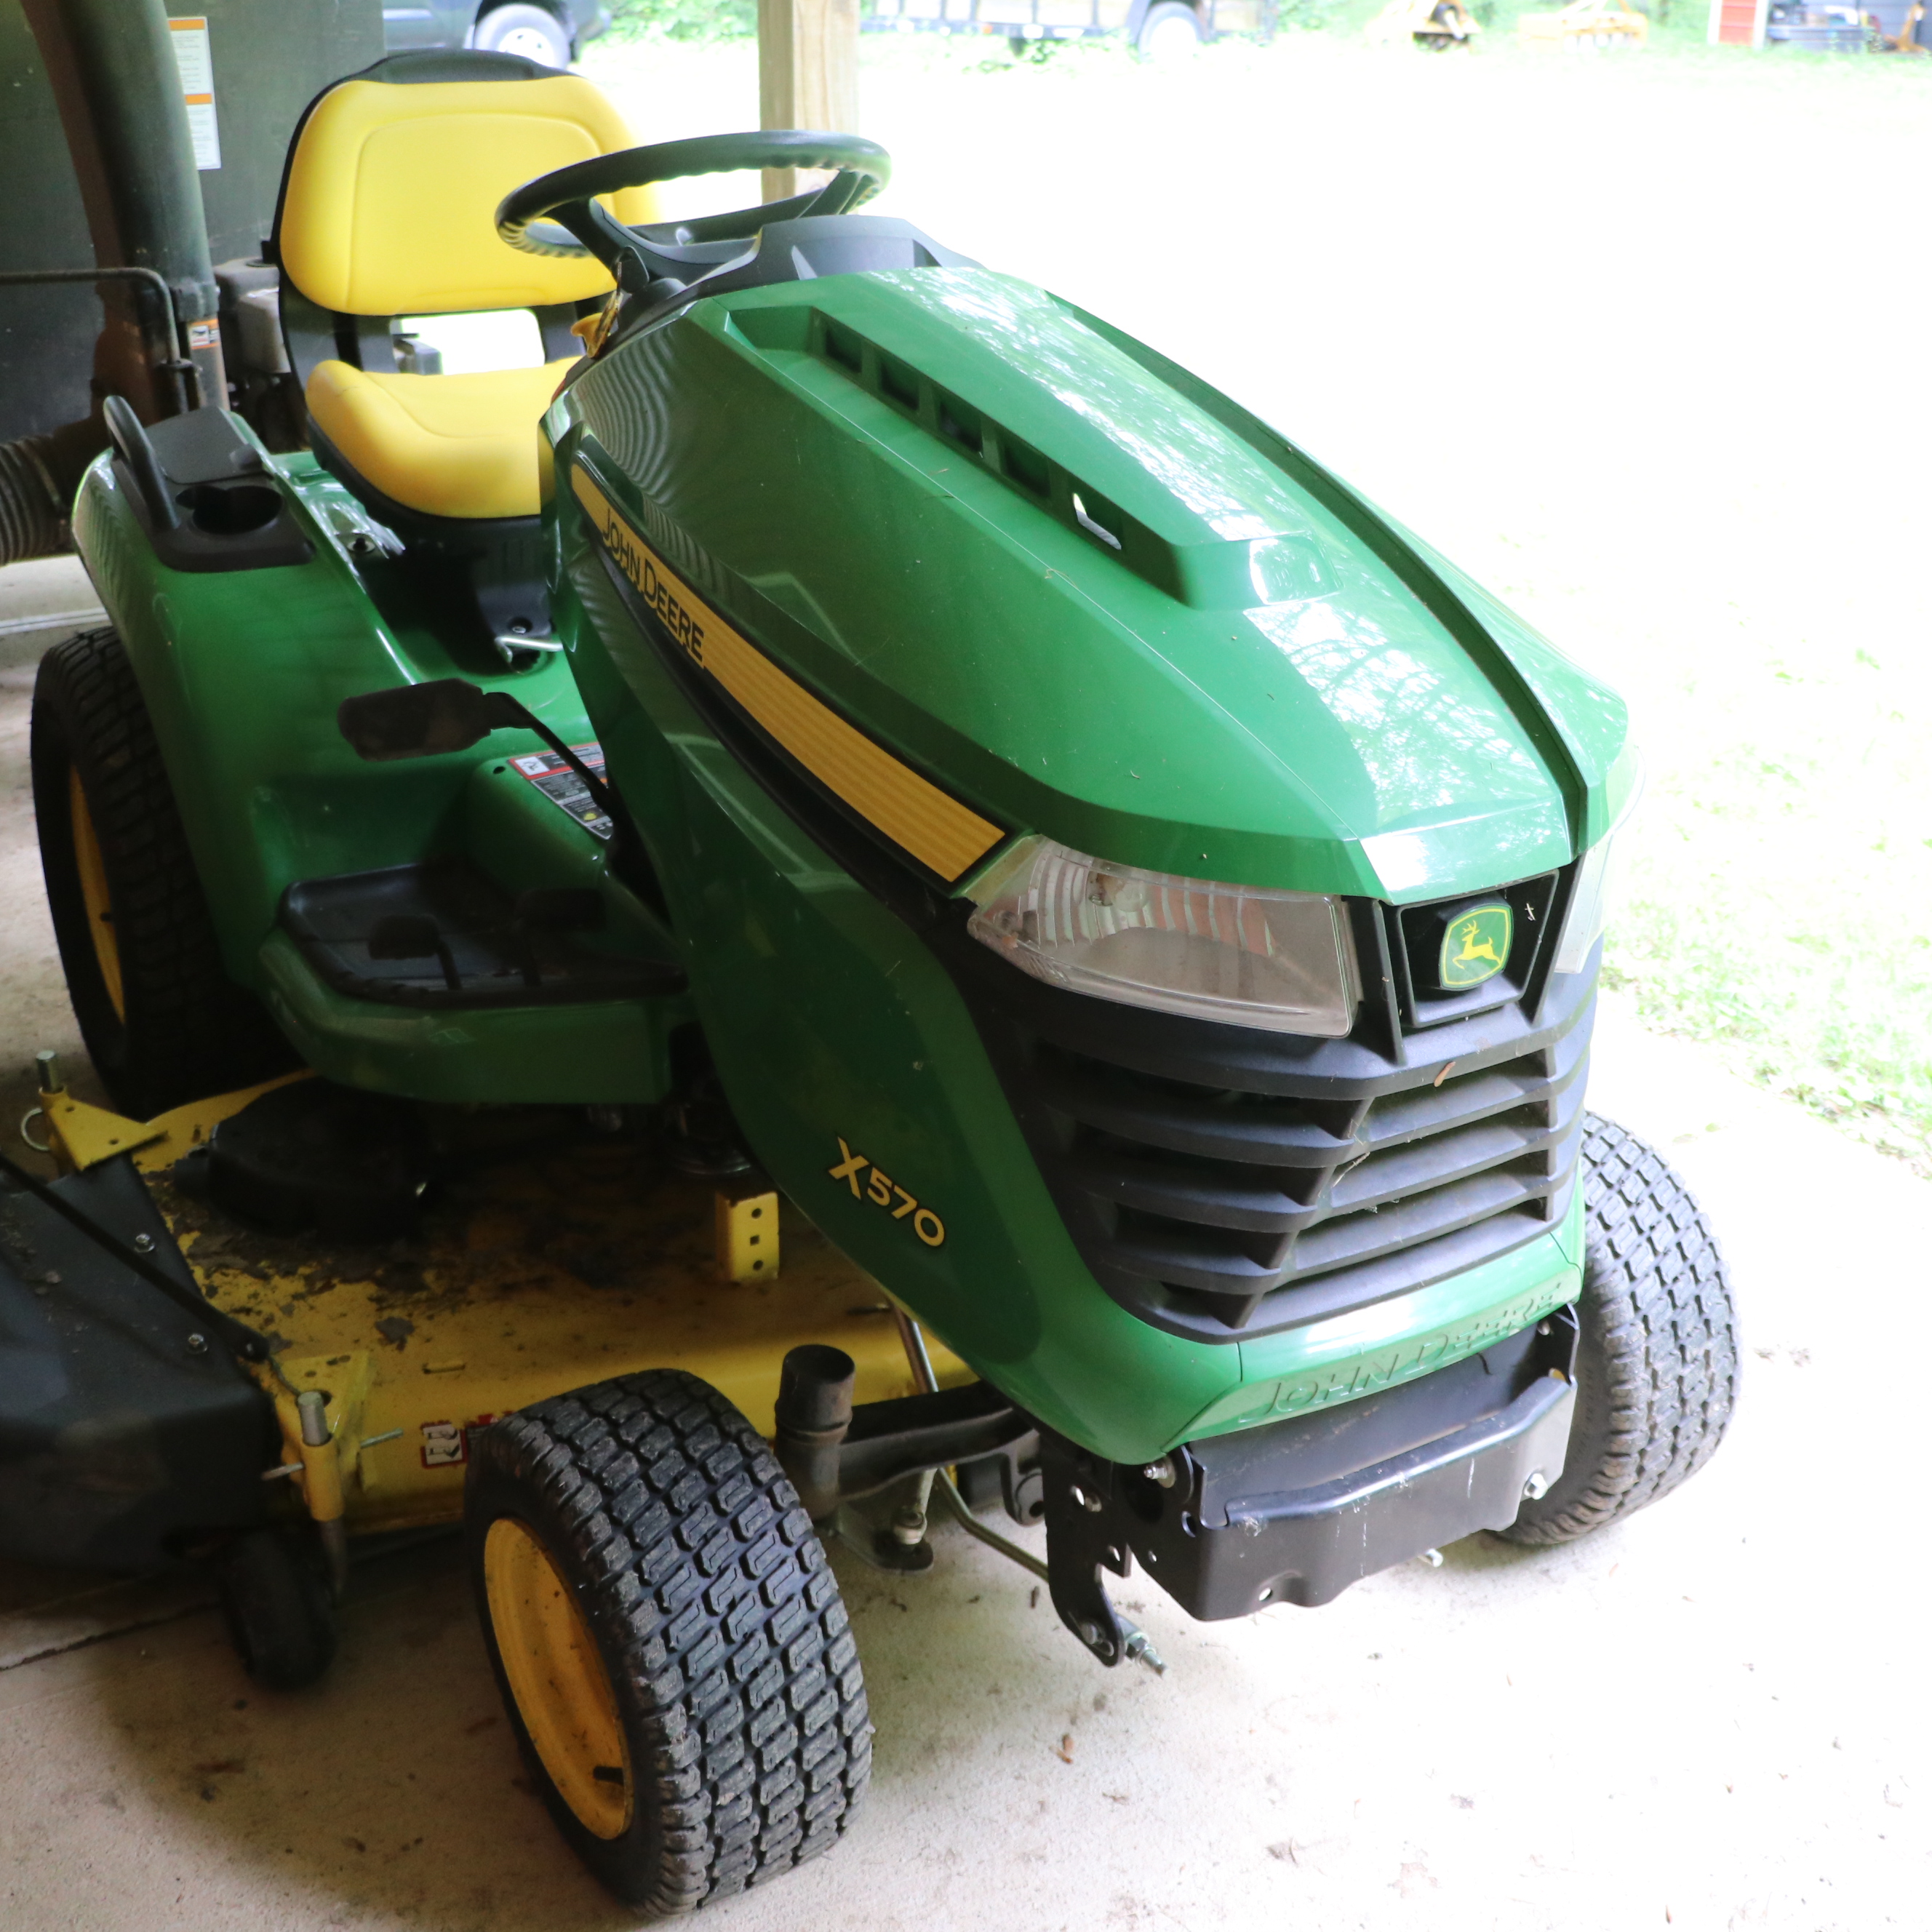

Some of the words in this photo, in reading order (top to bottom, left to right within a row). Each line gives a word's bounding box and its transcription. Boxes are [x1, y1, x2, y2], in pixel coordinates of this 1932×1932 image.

[602, 507, 641, 588] JOHN
[644, 559, 705, 663] DEERE
[829, 1136, 945, 1247] X570
[1238, 1353, 1400, 1424] JOHN
[1405, 1282, 1562, 1376] DEERE
